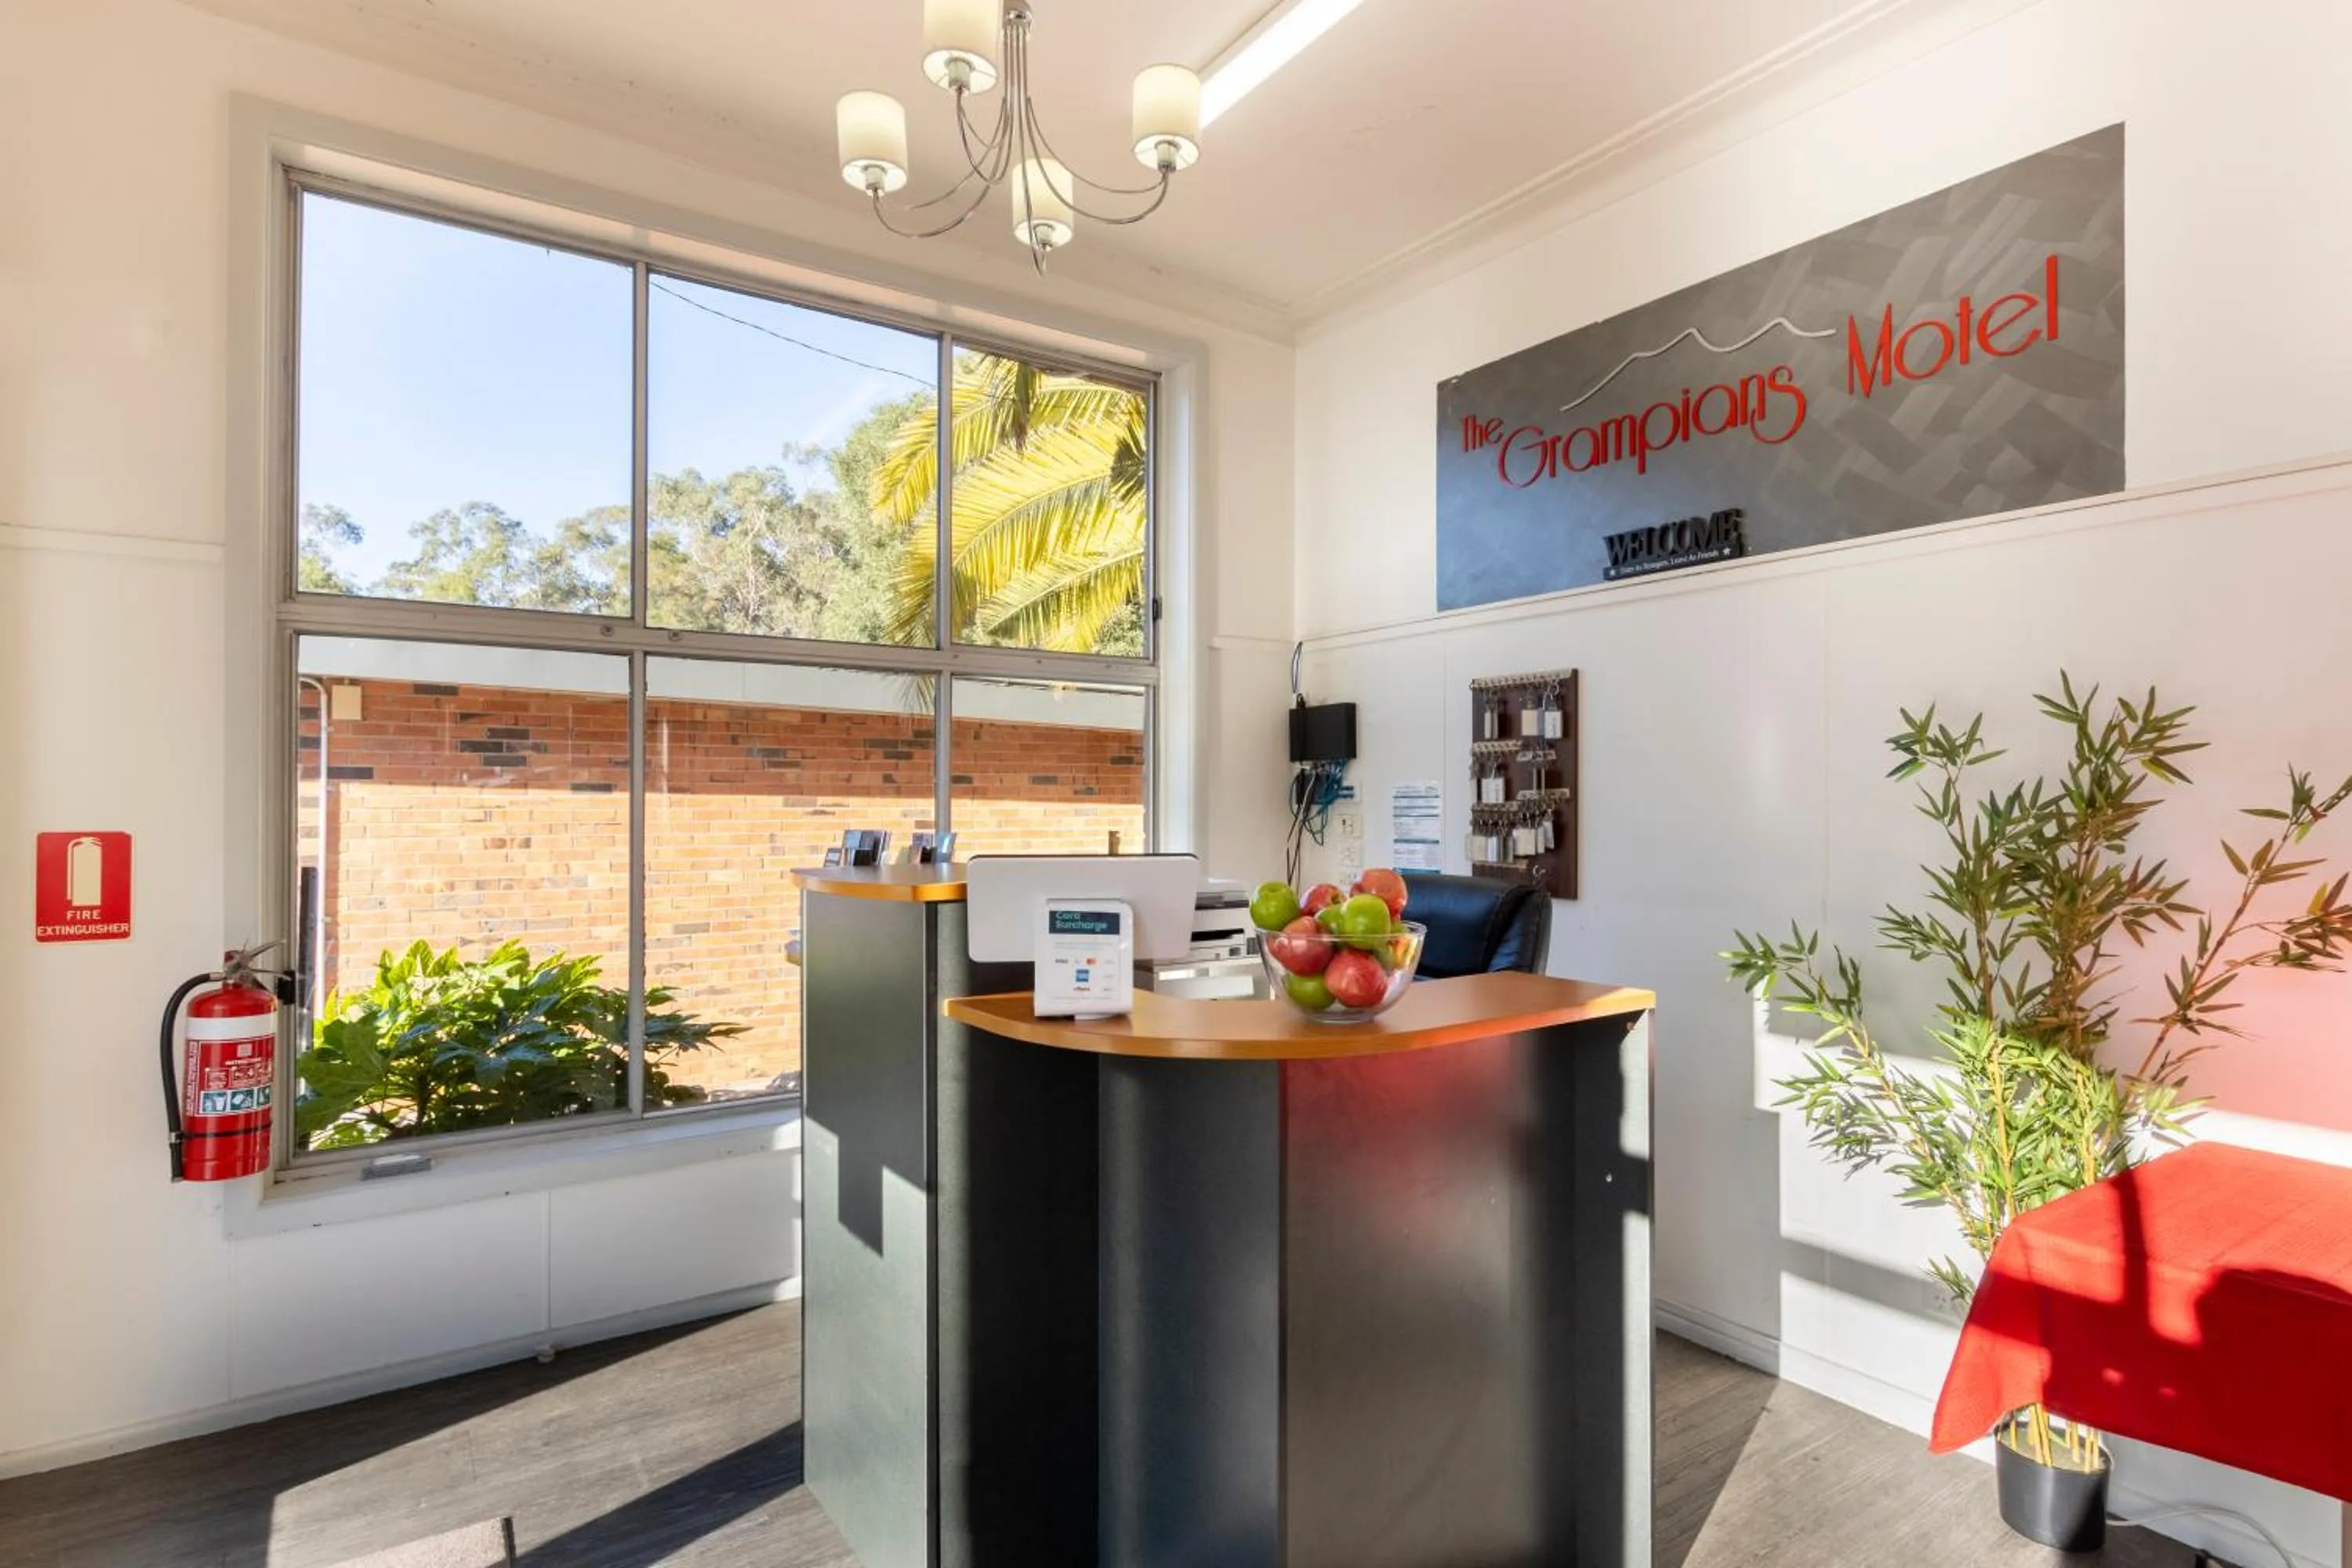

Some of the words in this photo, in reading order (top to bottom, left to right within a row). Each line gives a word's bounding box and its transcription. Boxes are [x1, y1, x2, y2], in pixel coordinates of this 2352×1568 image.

[1461, 414, 1504, 452] The
[1498, 365, 1806, 489] Grampians
[1847, 253, 2058, 398] Motel
[1602, 508, 1744, 566] WELCOME
[66, 909, 101, 921] FIRE
[1055, 911, 1081, 920] Card
[37, 923, 129, 937] EXTINGUISHER
[1055, 920, 1108, 931] Surcharge
